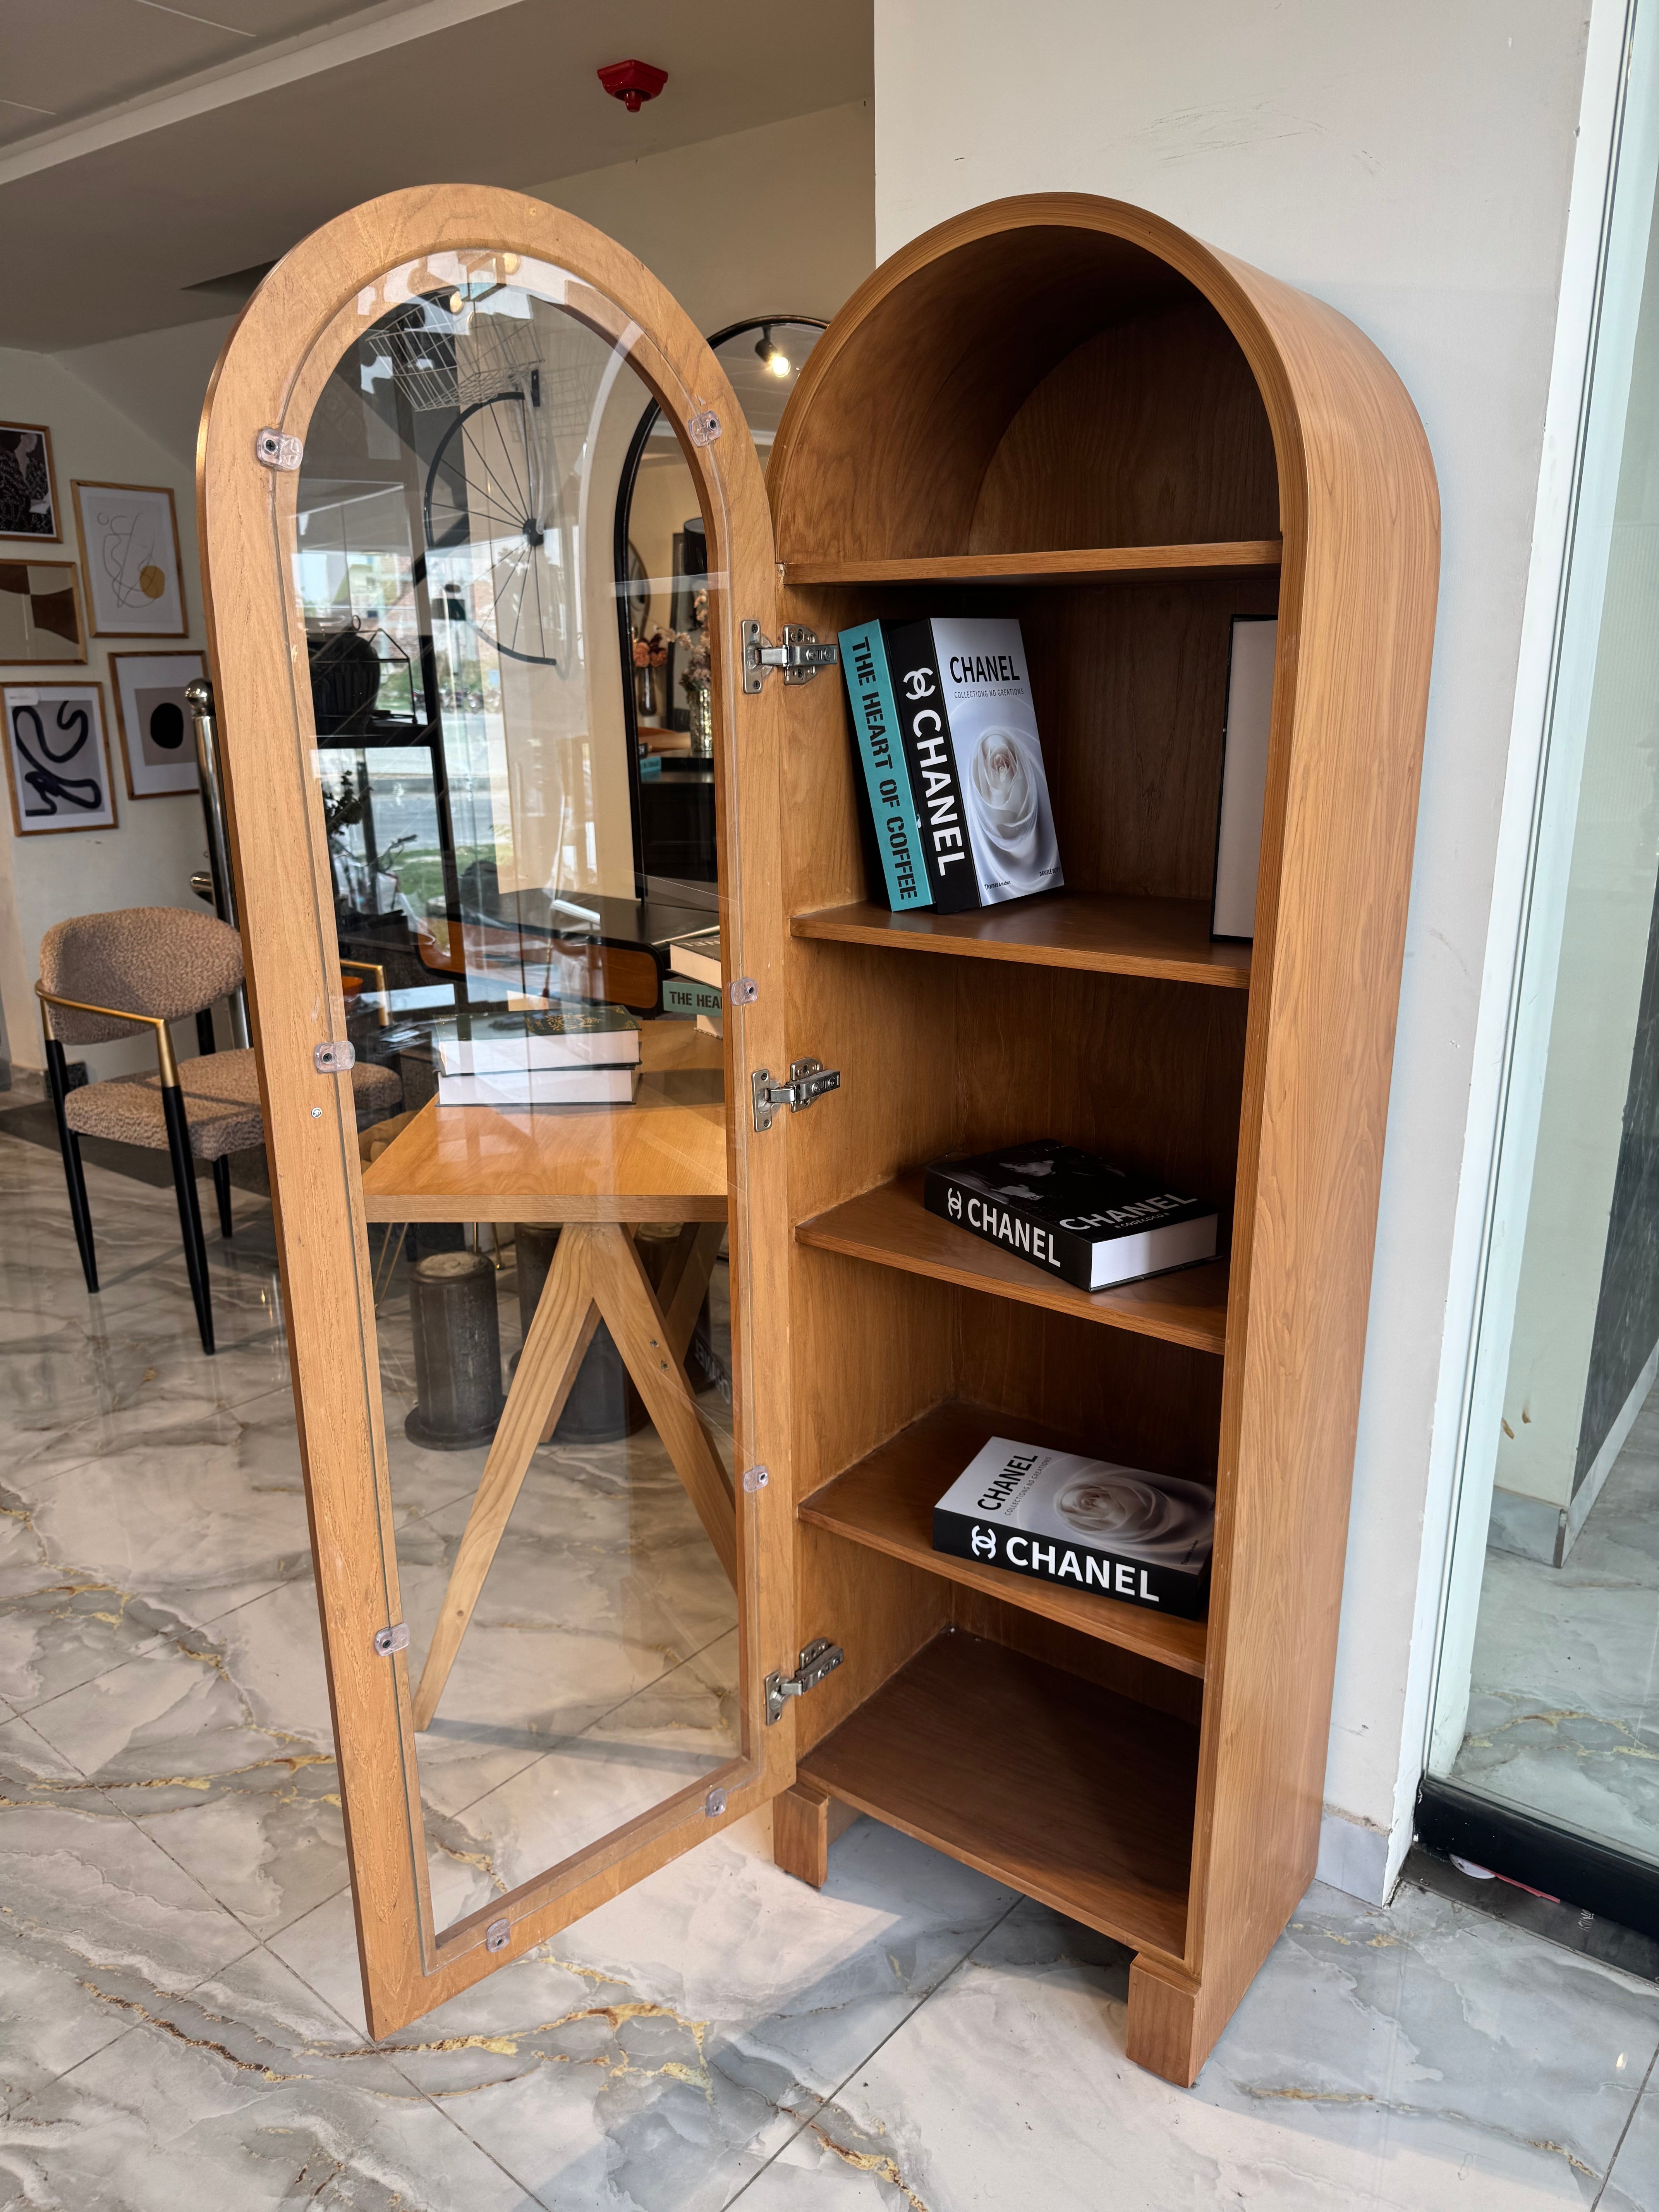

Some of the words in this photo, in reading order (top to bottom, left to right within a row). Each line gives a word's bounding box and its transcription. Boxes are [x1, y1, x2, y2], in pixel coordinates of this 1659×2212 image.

[852, 636, 876, 686] THE
[950, 656, 1020, 683] CHANEL
[862, 692, 893, 769] HEART
[879, 779, 900, 807] OF
[913, 709, 965, 876] CHANEL
[887, 816, 917, 900] COFFEE
[669, 991, 692, 1006] THE
[697, 994, 722, 1009] HEA
[968, 1199, 1060, 1267] CHANEL
[1060, 1194, 1198, 1230] CHANEL
[977, 1455, 1038, 1510] CHANEL
[1006, 1537, 1159, 1602] CHANEL
